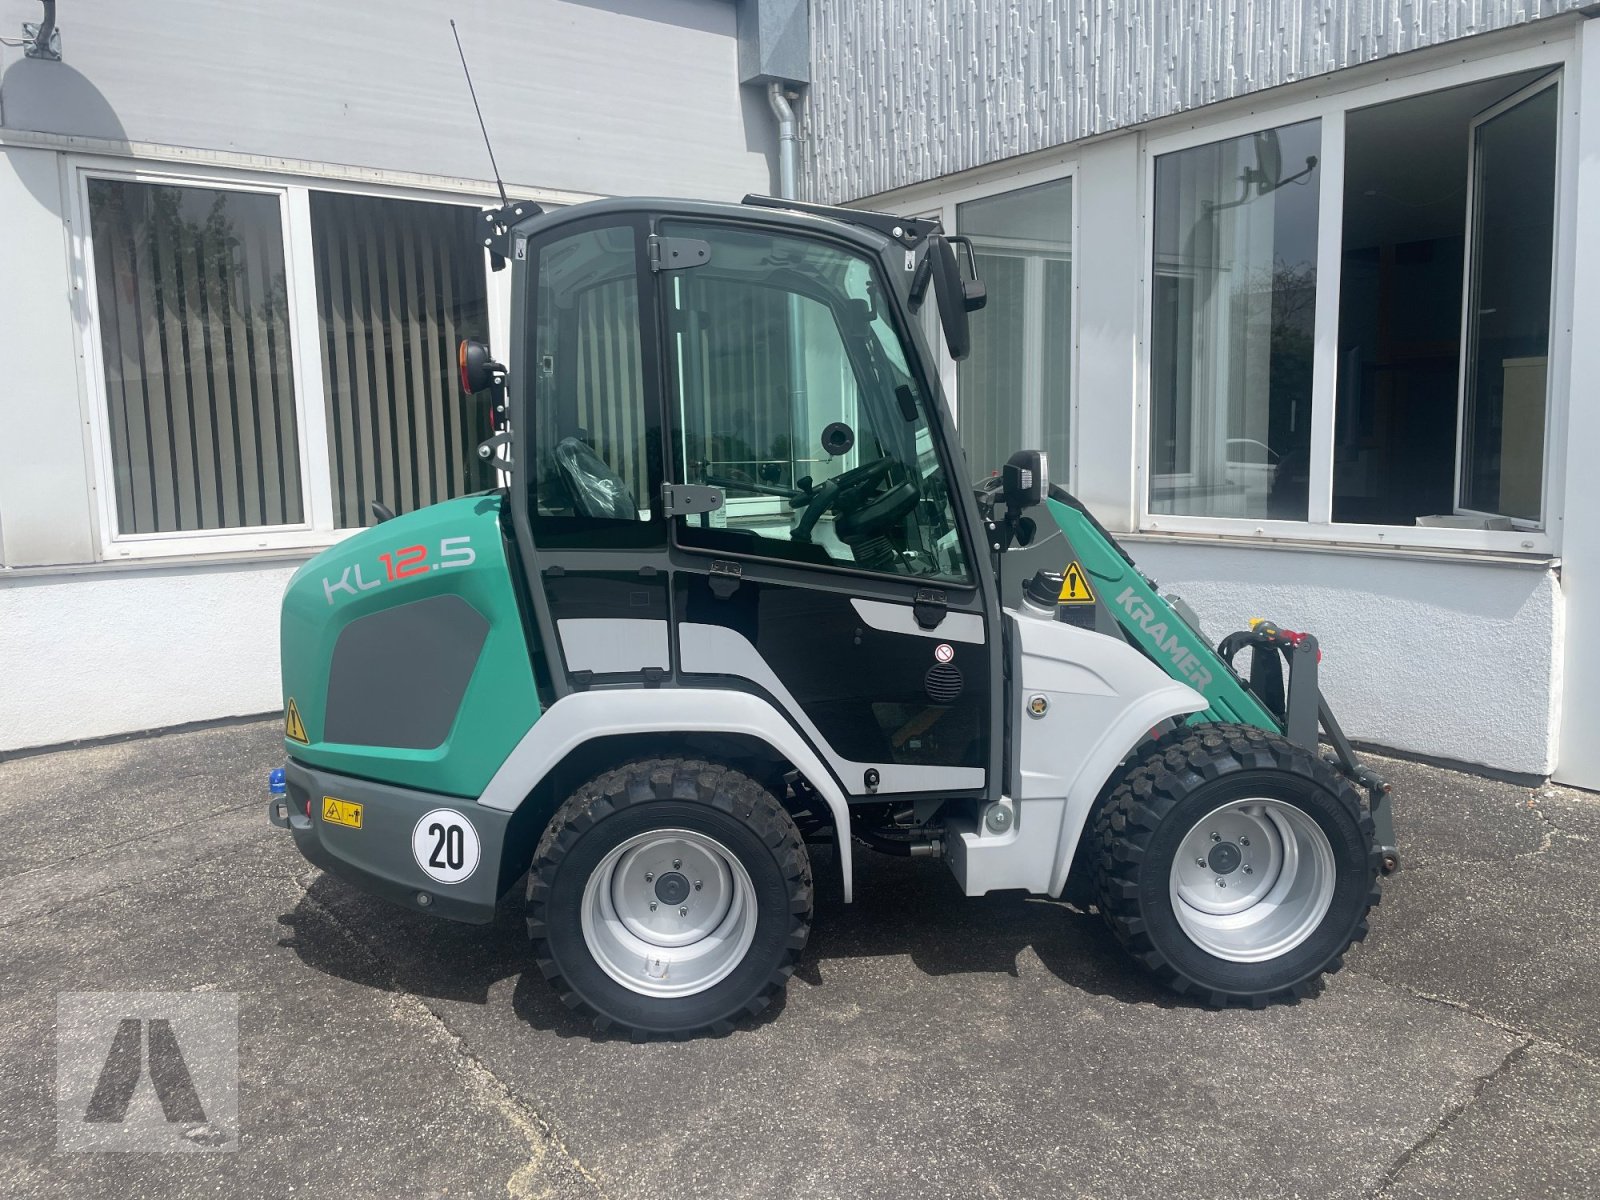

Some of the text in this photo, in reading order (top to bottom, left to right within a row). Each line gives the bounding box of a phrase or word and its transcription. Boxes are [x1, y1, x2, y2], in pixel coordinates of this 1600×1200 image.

[322, 536, 476, 605] KL12.5
[1115, 586, 1213, 693] KRAMER
[428, 822, 464, 870] 20
